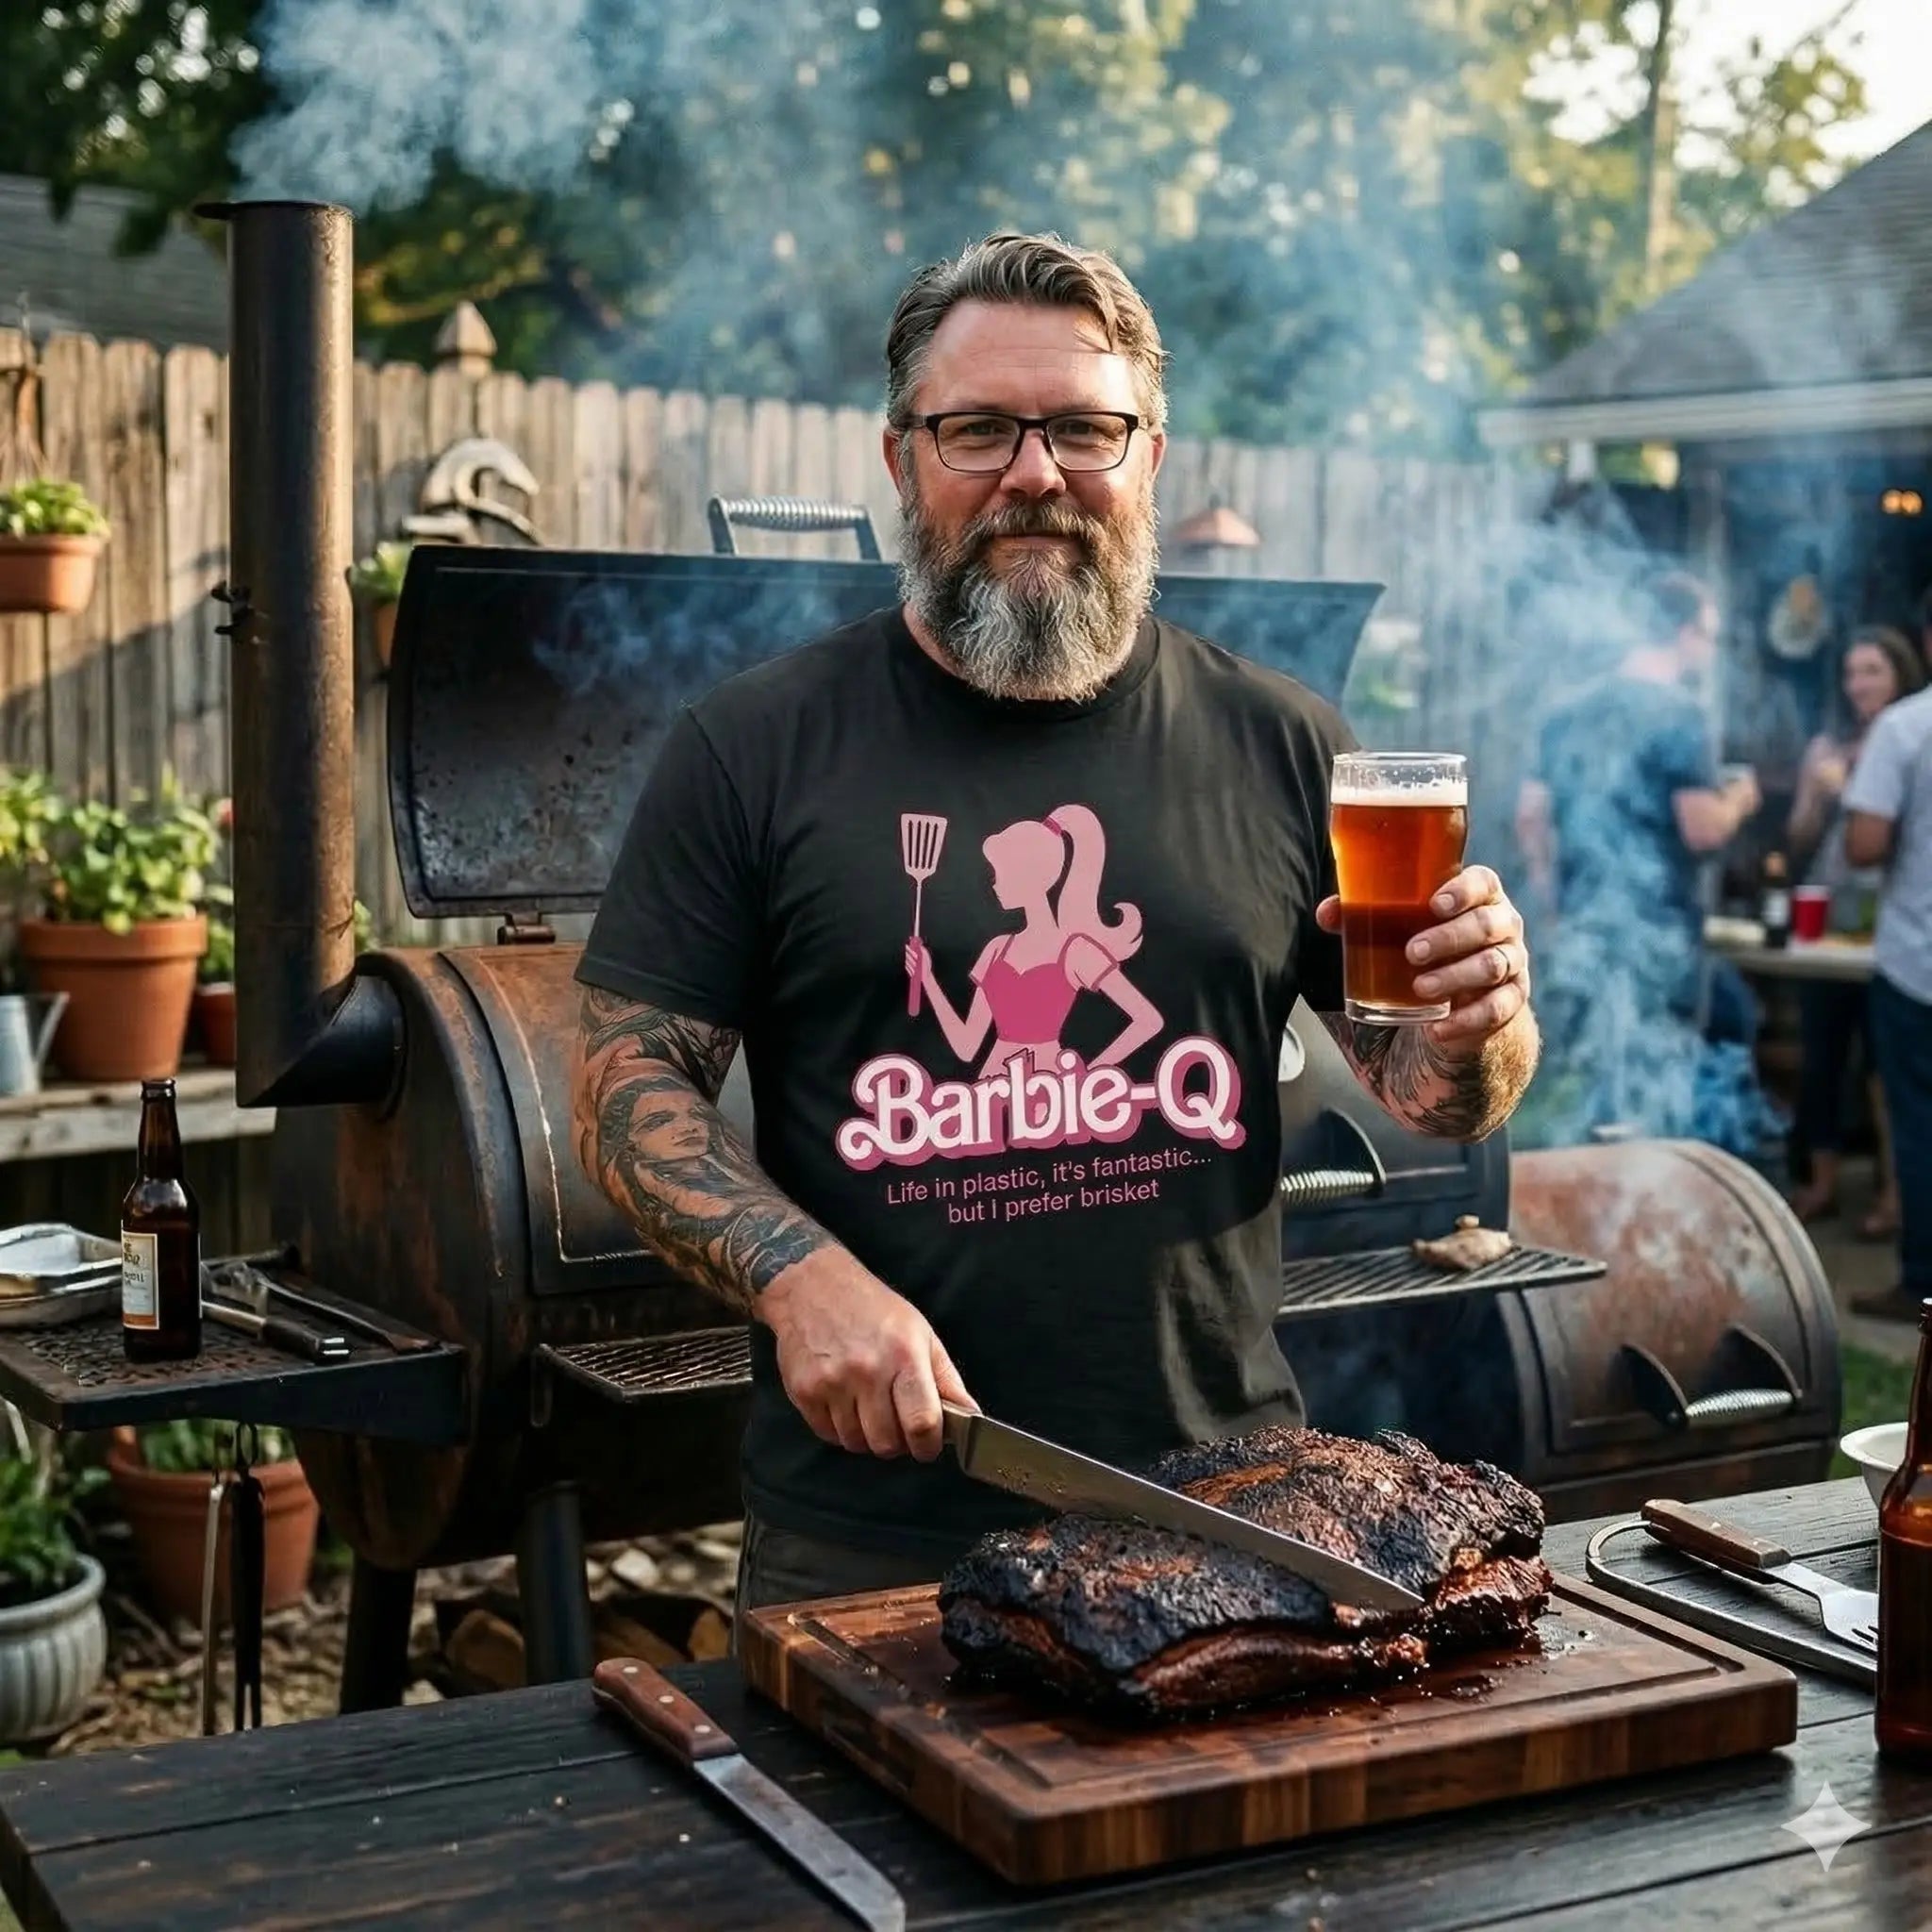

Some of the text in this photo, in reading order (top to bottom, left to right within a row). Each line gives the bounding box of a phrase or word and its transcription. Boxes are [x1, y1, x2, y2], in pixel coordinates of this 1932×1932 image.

[835, 1035, 1246, 1171] Barbie-Q
[888, 1147, 1211, 1204] Life in plastic, it's fantastic...
[948, 1179, 1160, 1224] but I prefer brisket
